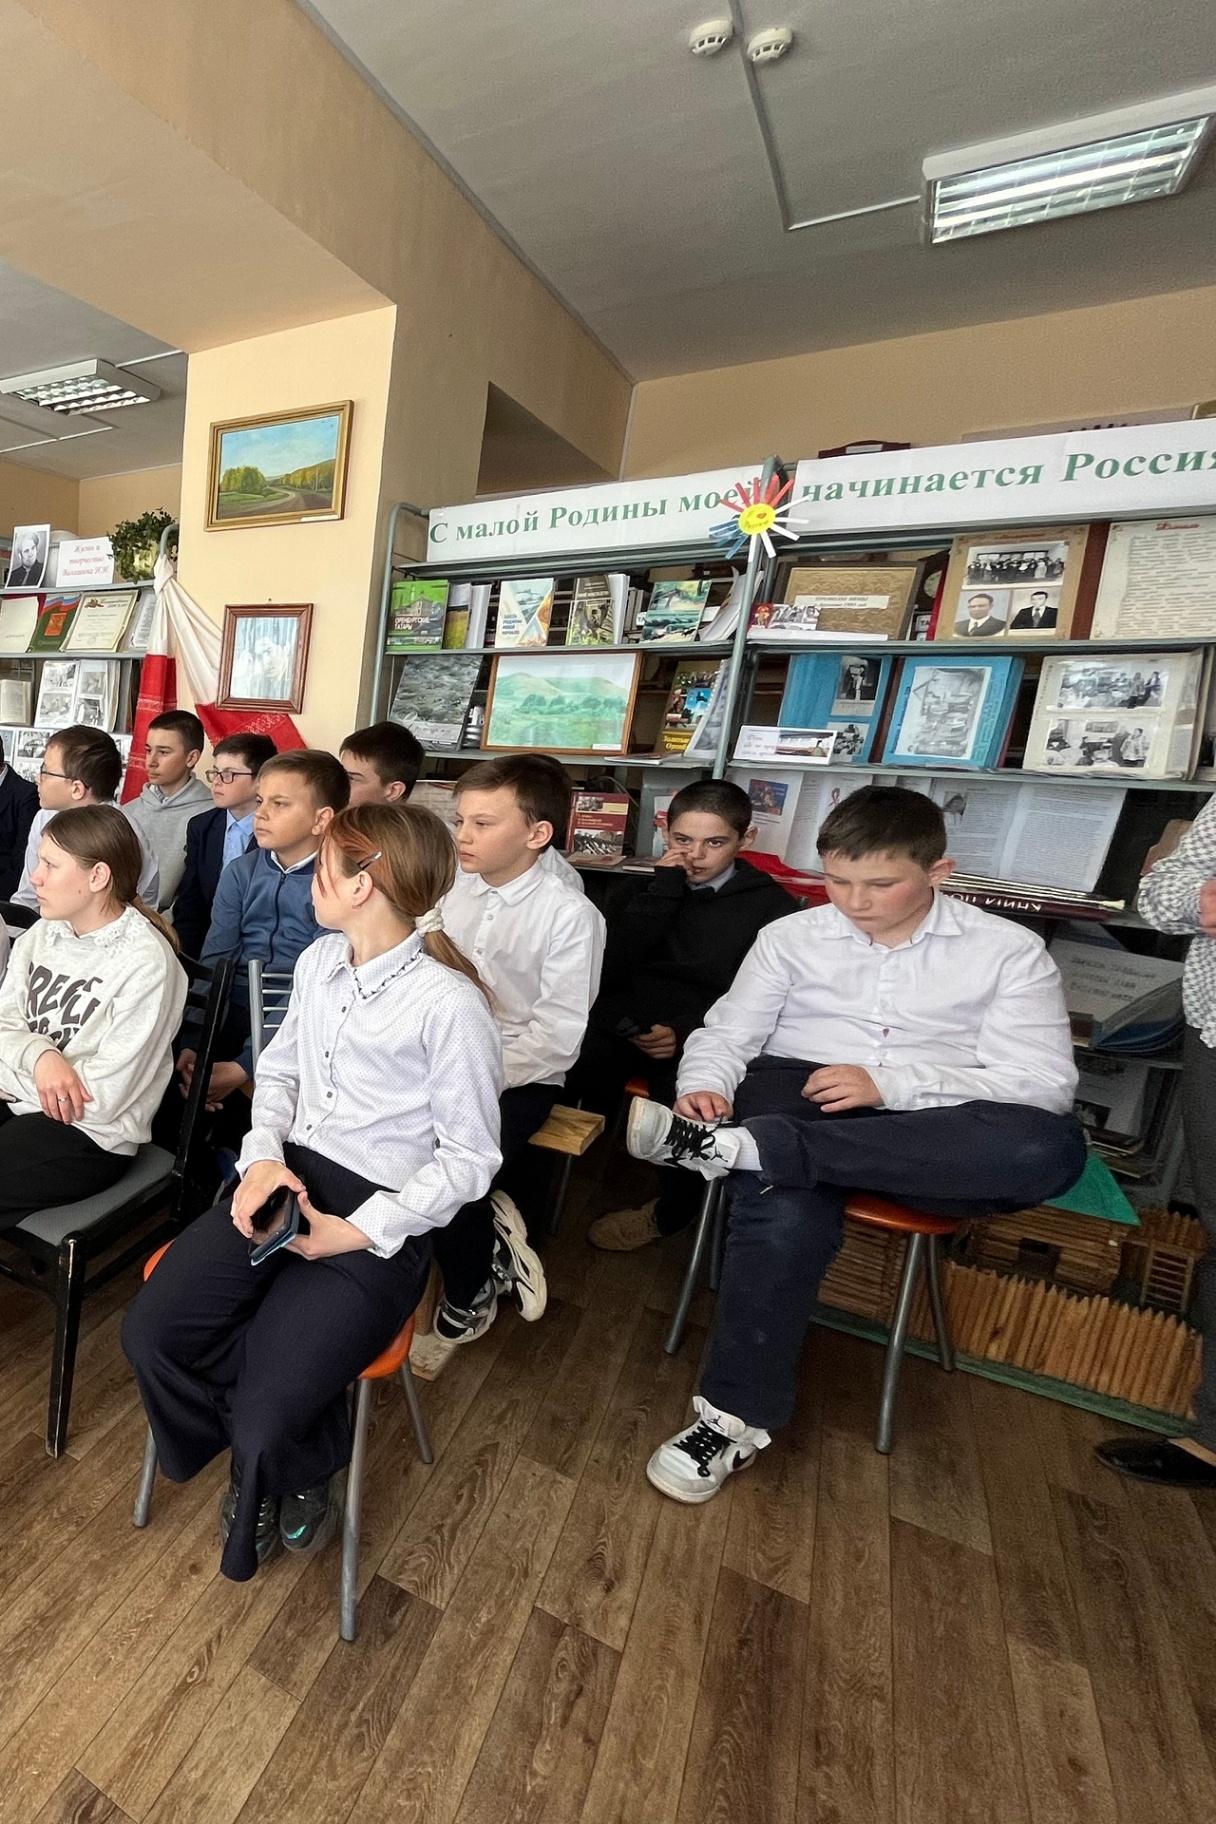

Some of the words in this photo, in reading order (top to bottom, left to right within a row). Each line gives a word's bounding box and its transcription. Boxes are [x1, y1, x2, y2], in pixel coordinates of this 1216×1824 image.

[429, 522, 449, 544] С
[455, 511, 540, 542] малой
[548, 501, 668, 529] Родины
[801, 463, 1045, 503] начинается
